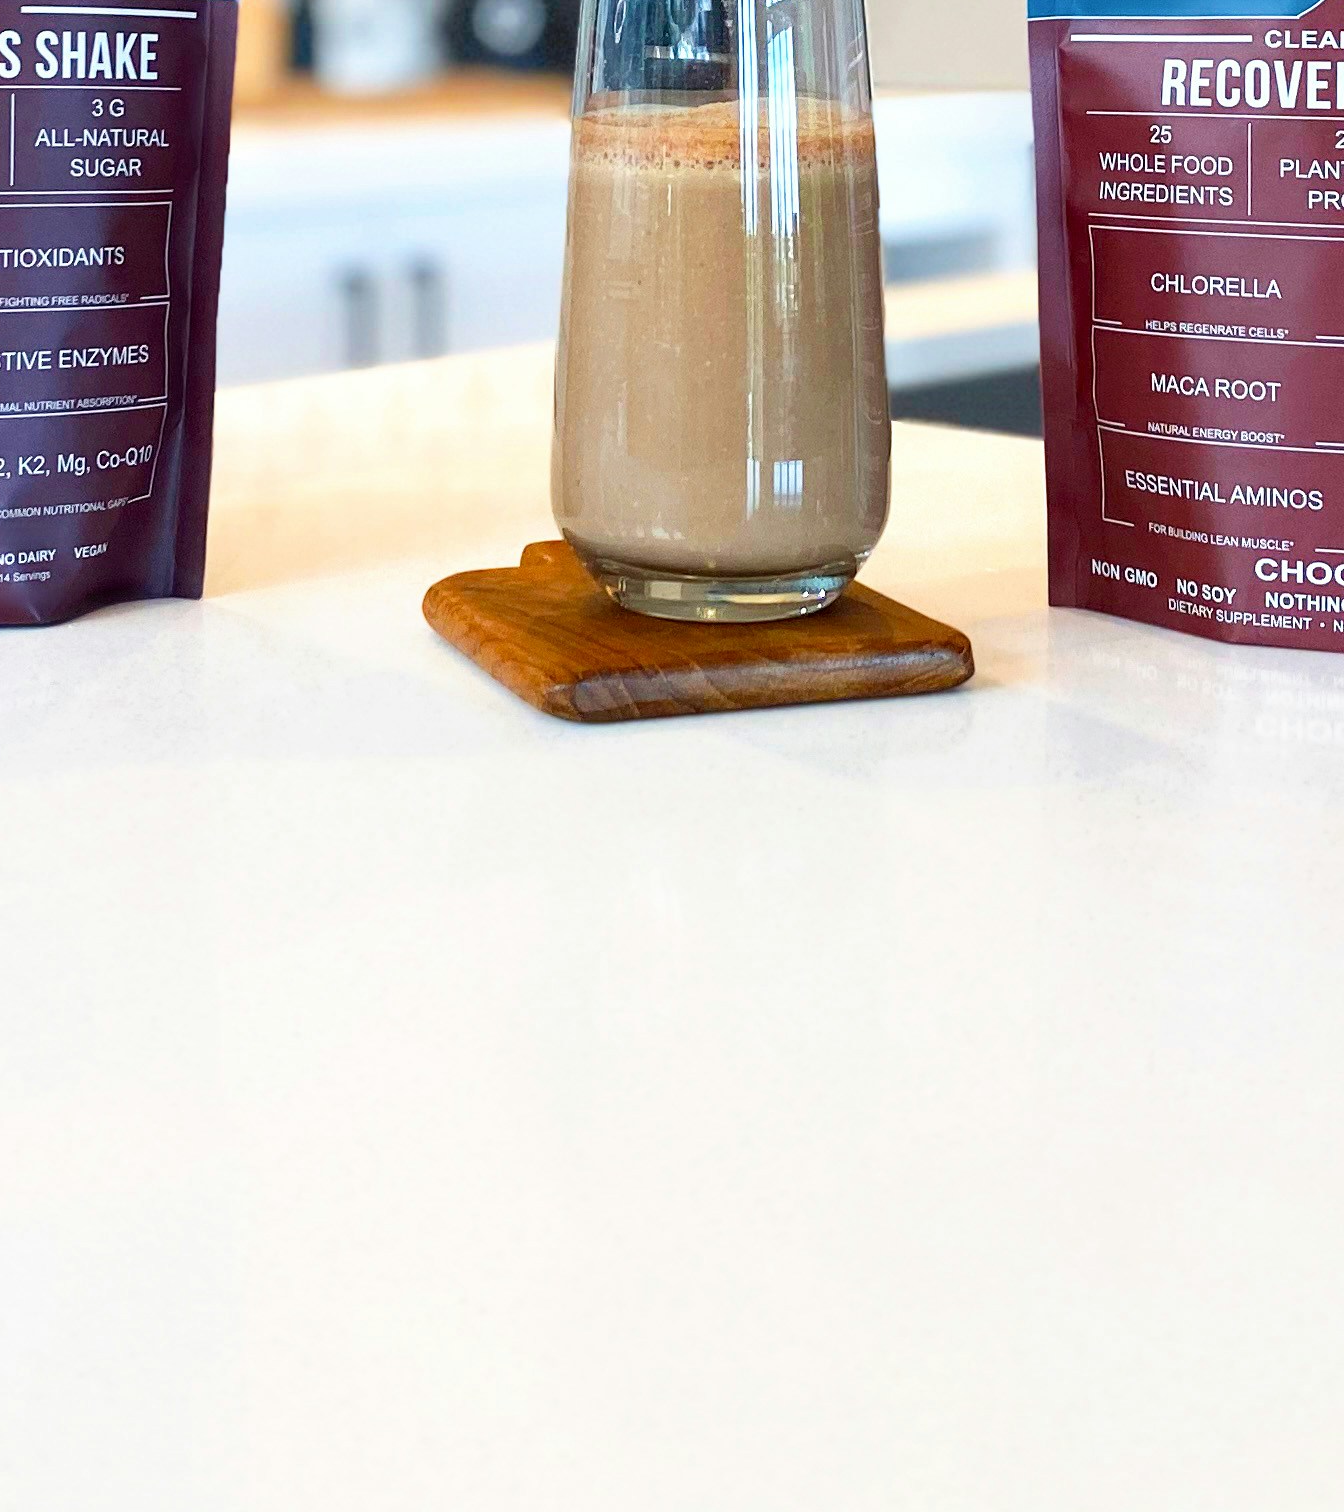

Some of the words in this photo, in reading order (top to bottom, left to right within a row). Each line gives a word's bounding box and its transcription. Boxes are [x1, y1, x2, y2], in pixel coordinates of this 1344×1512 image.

[36, 31, 158, 79] SHAKE
[92, 99, 103, 116] 3
[110, 99, 124, 117] G
[35, 129, 169, 147] ALL-NATURAL
[1150, 125, 1171, 143] 25
[70, 159, 141, 176] SUGAR
[1099, 152, 1165, 173] WHOLE
[1172, 155, 1232, 175] FOOD
[1100, 182, 1233, 205] INGREDIENTS
[1151, 273, 1282, 298] CHLORELLA
[51, 295, 79, 305] FREE
[1146, 320, 1177, 331] HELPS
[59, 345, 148, 368] ENZYMES
[1152, 373, 1209, 396] MACA
[1215, 379, 1281, 401] ROOT
[1148, 422, 1190, 436] NATURAL
[1193, 427, 1238, 440] ENERGY
[19, 456, 50, 476] K2,
[58, 454, 90, 475] Mg,
[97, 445, 152, 469] Co-Q10
[1126, 470, 1226, 503] ESSENTIAL
[1230, 485, 1323, 510] AMINOS
[1211, 534, 1238, 547] LEAN
[19, 549, 56, 563] DAIRY
[1092, 559, 1120, 580] NON
[1125, 568, 1157, 587] GMO
[1177, 579, 1198, 597] NO
[1202, 585, 1236, 604] SOY
[1169, 598, 1213, 618] DIETARY
[1216, 609, 1312, 630] SUPPLEMENT
